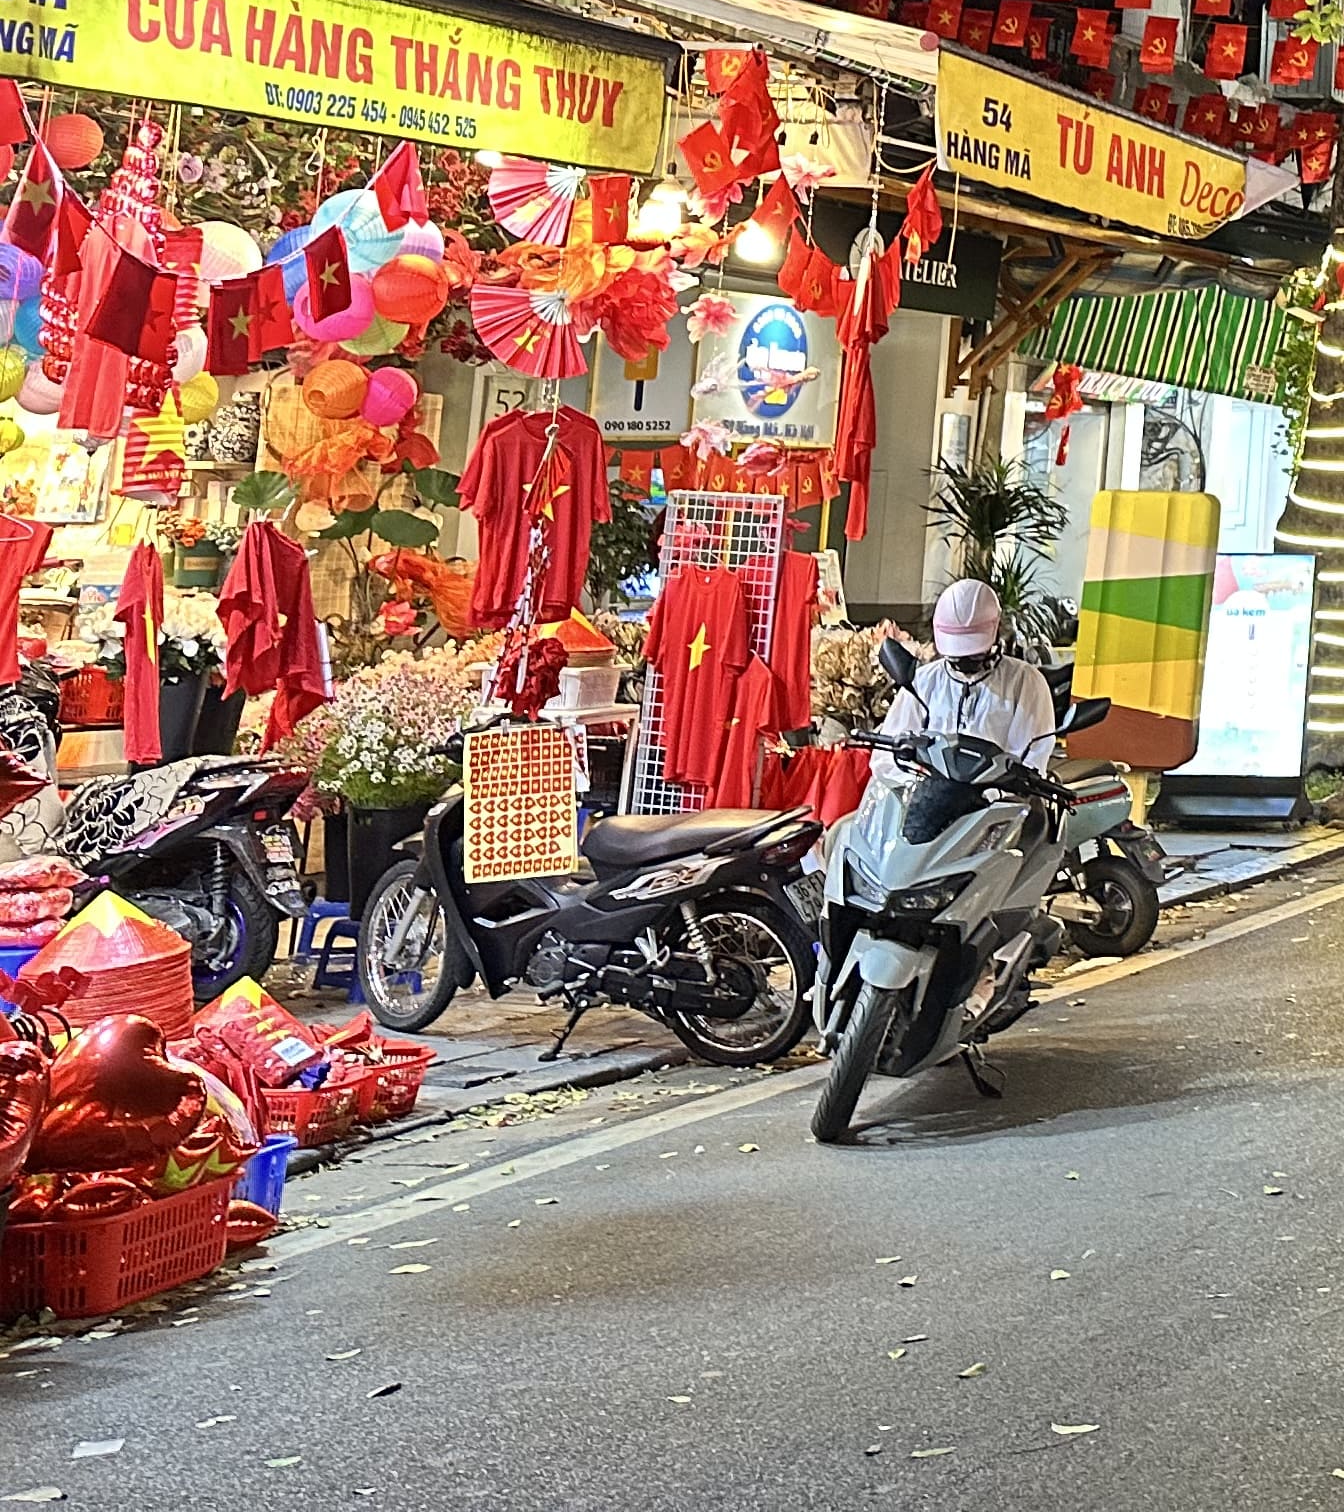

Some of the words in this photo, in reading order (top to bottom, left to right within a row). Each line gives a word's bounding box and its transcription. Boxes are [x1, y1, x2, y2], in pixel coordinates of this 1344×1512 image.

[245, 0, 374, 85] HÀNG
[391, 27, 521, 112] THẮNG
[533, 63, 624, 128] THÚY
[286, 87, 323, 115] 0903
[326, 93, 355, 119] 225
[361, 97, 387, 125] 454
[399, 105, 426, 131] 0945
[427, 111, 450, 136] 452
[455, 115, 477, 139] 525
[947, 129, 1000, 169] HÀNG
[1005, 145, 1031, 180] MÃ
[982, 97, 1012, 133] 54
[1057, 111, 1094, 175] TÚ
[1106, 134, 1166, 199] ANH
[496, 389, 525, 417] 52
[604, 420, 625, 431] 090
[645, 420, 671, 431] 5252
